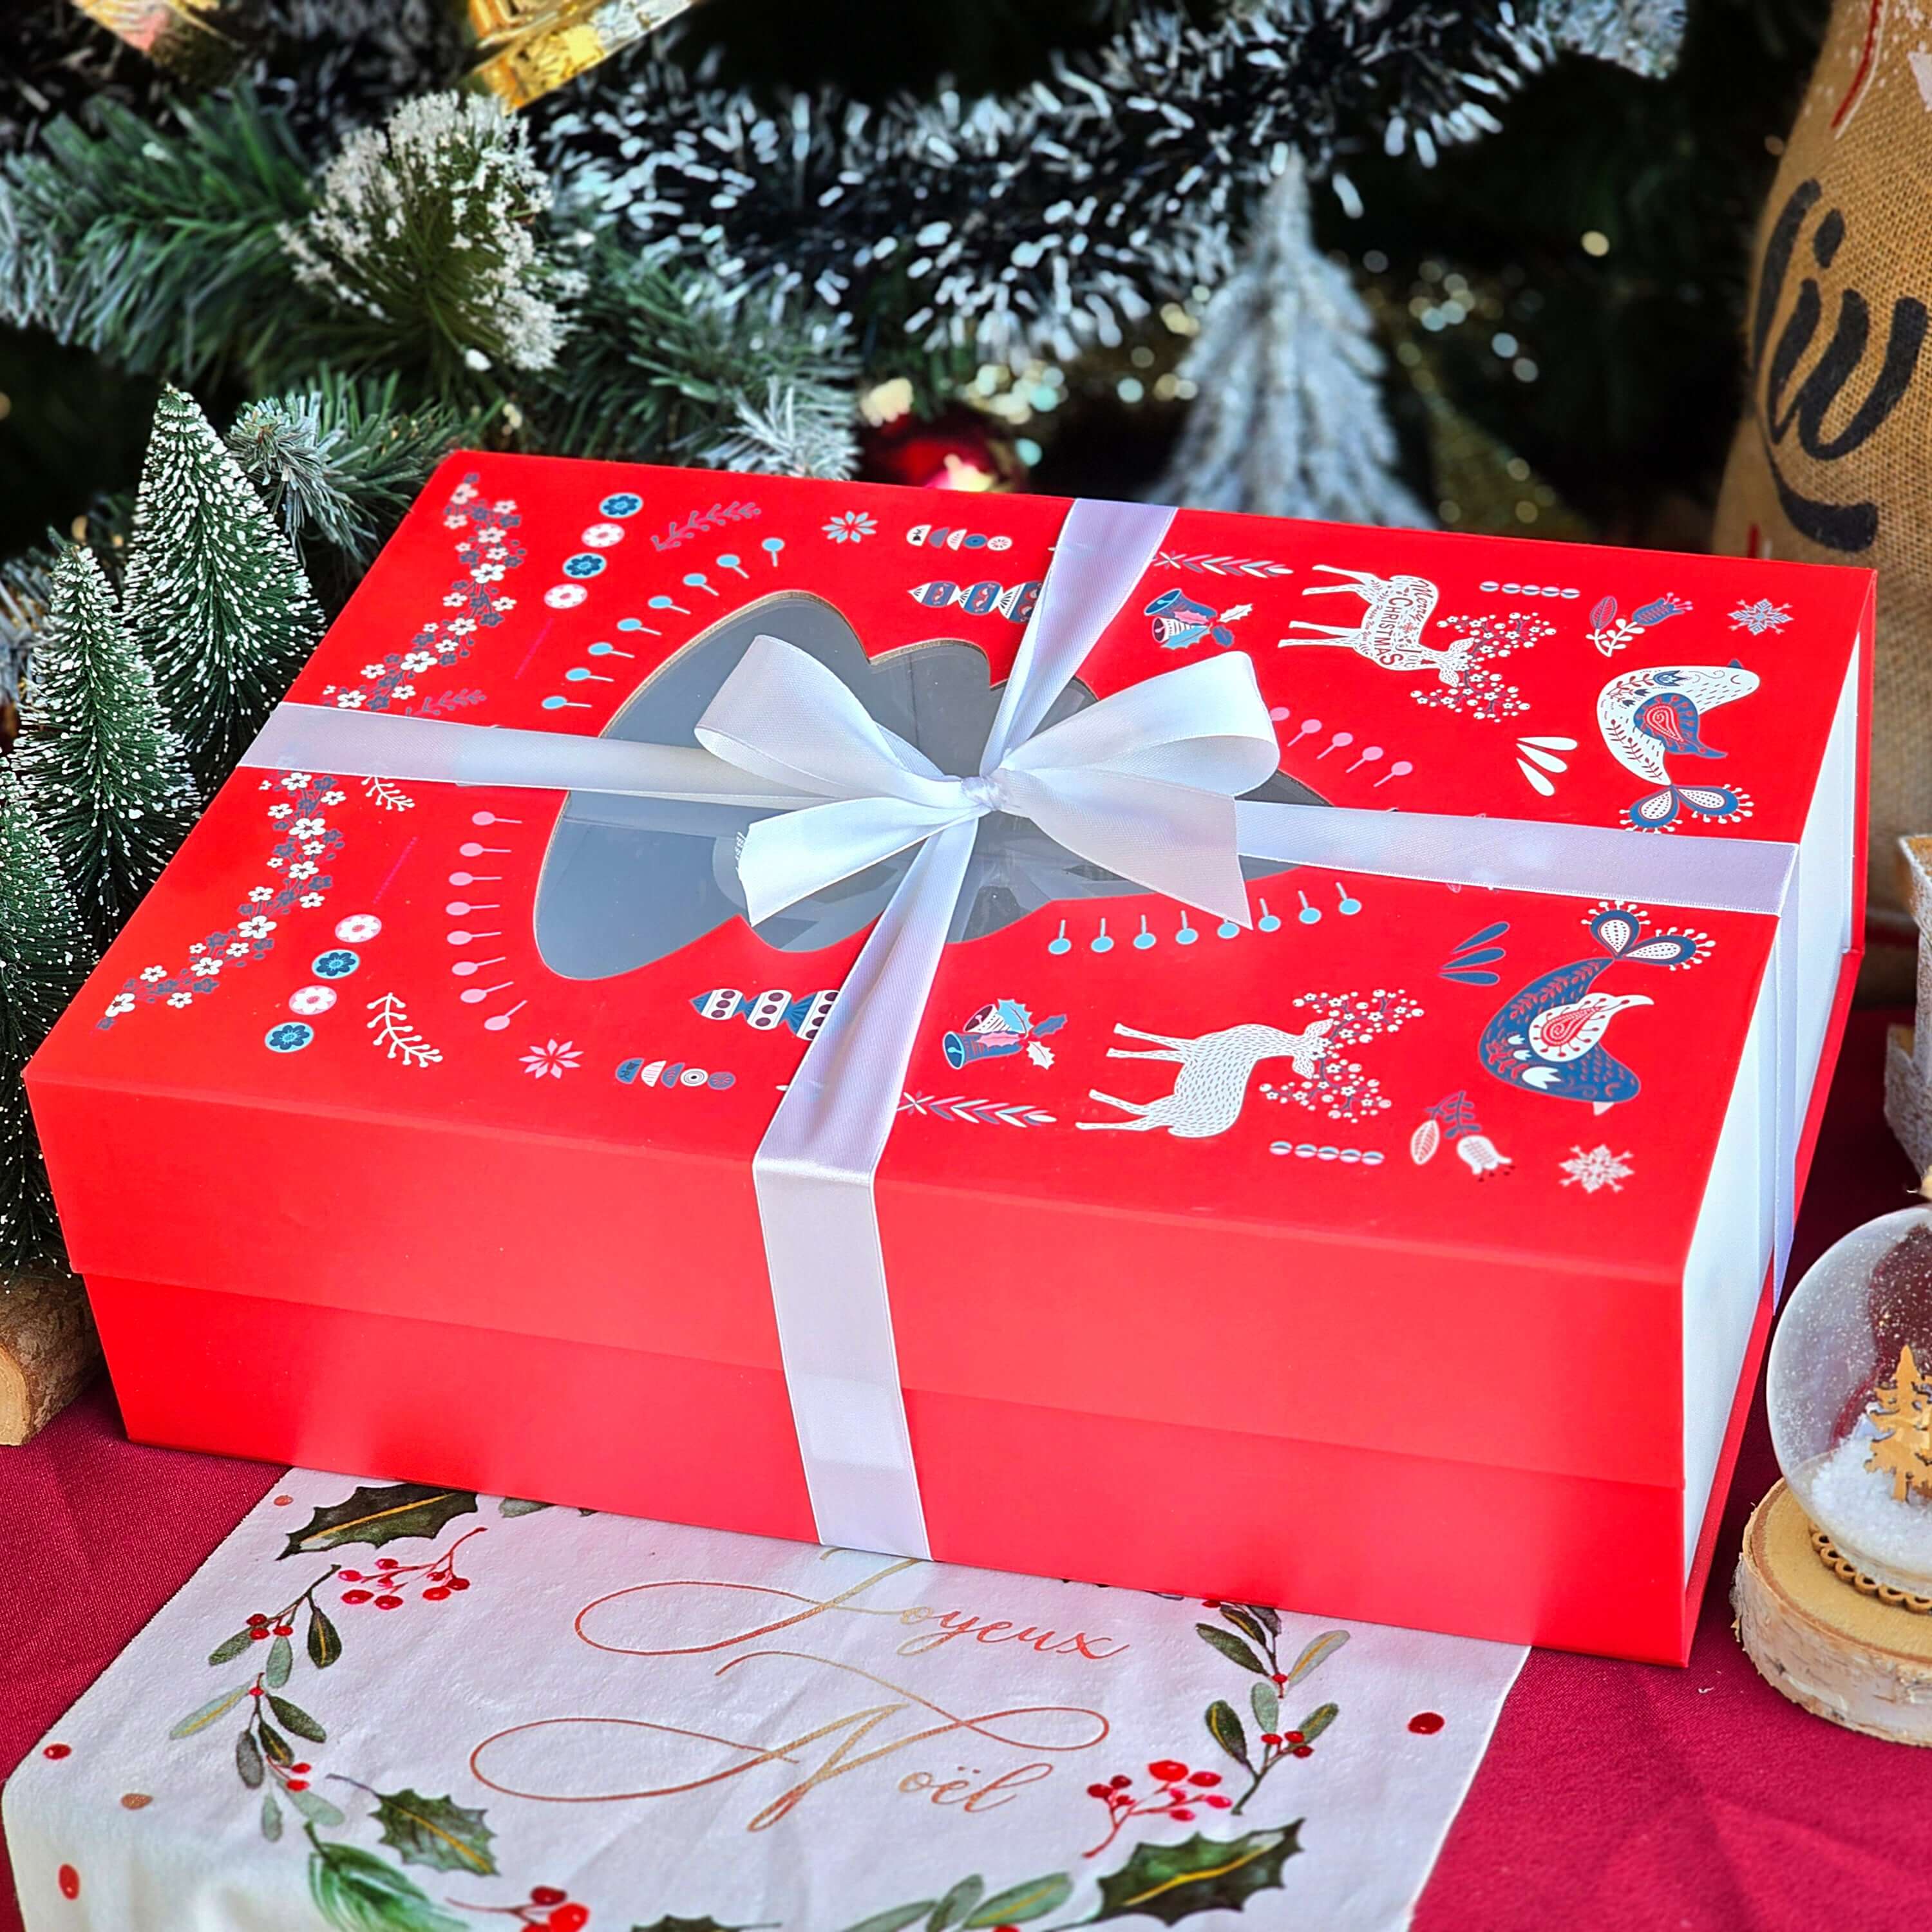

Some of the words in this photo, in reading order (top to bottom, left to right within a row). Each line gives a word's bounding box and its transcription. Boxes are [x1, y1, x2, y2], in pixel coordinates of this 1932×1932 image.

[1374, 597, 1414, 665] CHRISTMAS
[1408, 580, 1434, 622] Merry
[471, 1651, 1109, 1832] Noël
